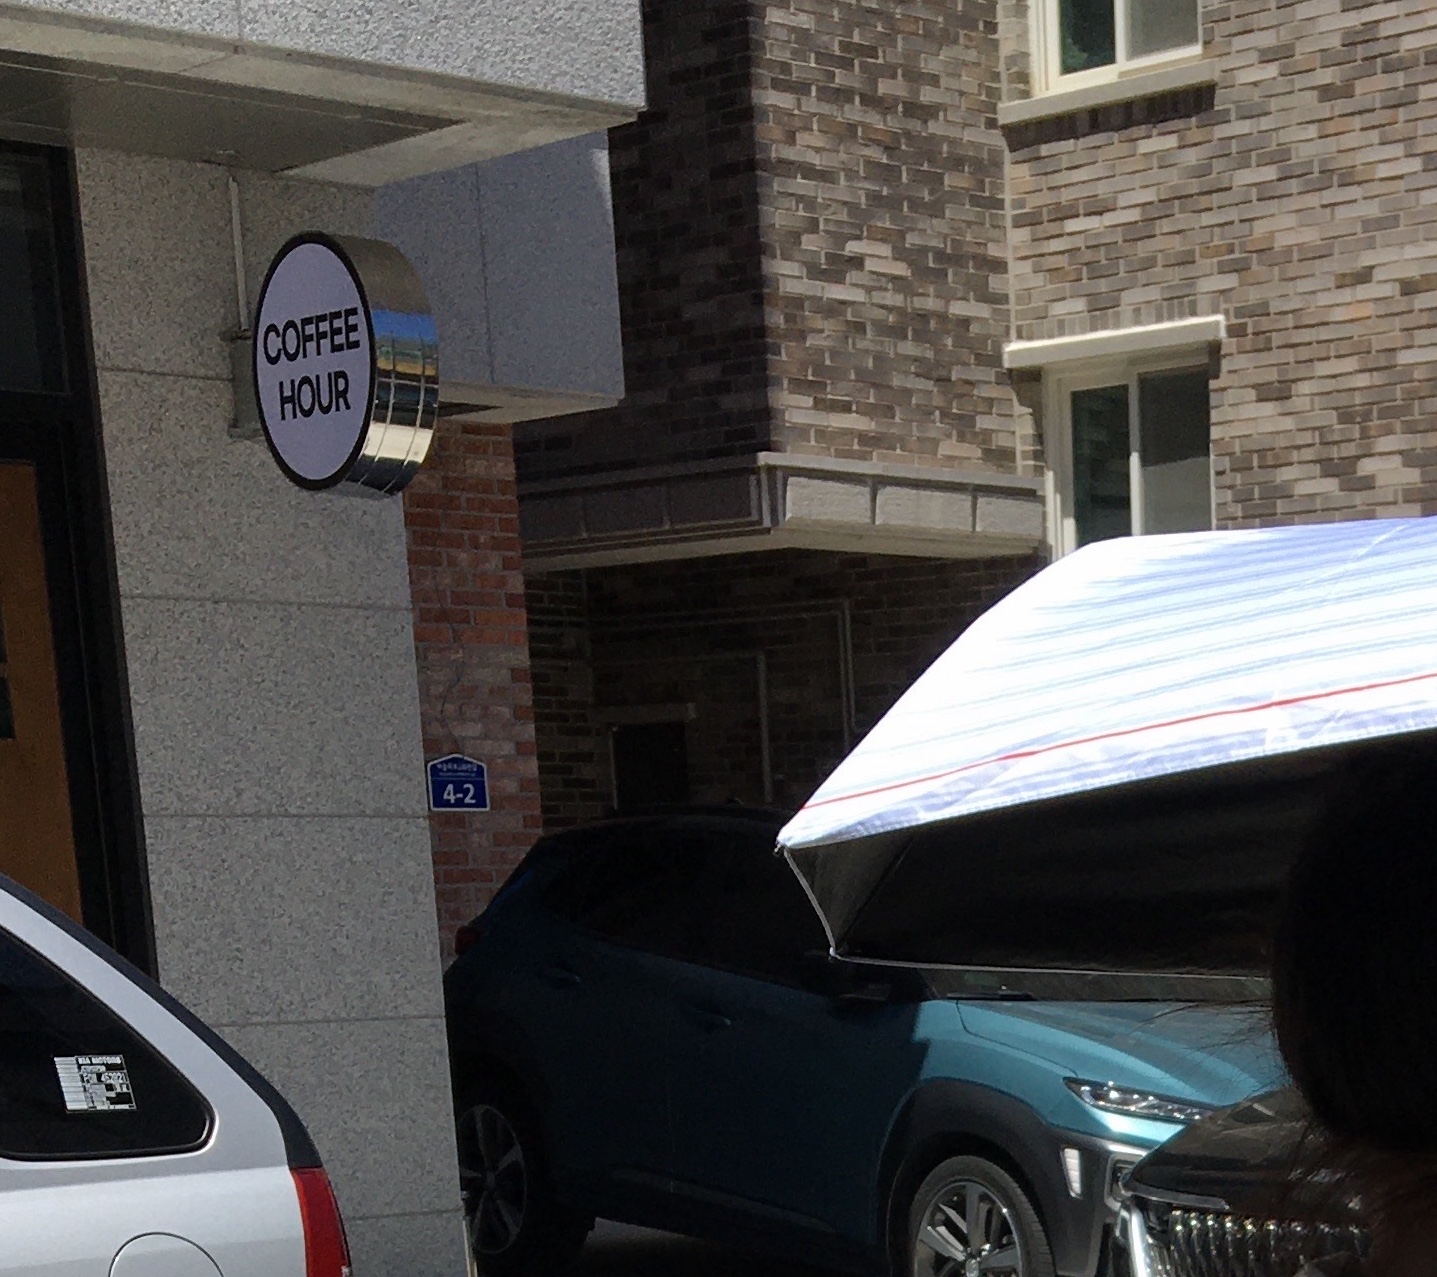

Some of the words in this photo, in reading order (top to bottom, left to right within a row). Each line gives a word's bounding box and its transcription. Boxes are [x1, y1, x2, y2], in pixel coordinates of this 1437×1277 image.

[263, 307, 360, 365] COFFEE
[279, 370, 351, 421] HOUR
[443, 783, 476, 804] 4-2
